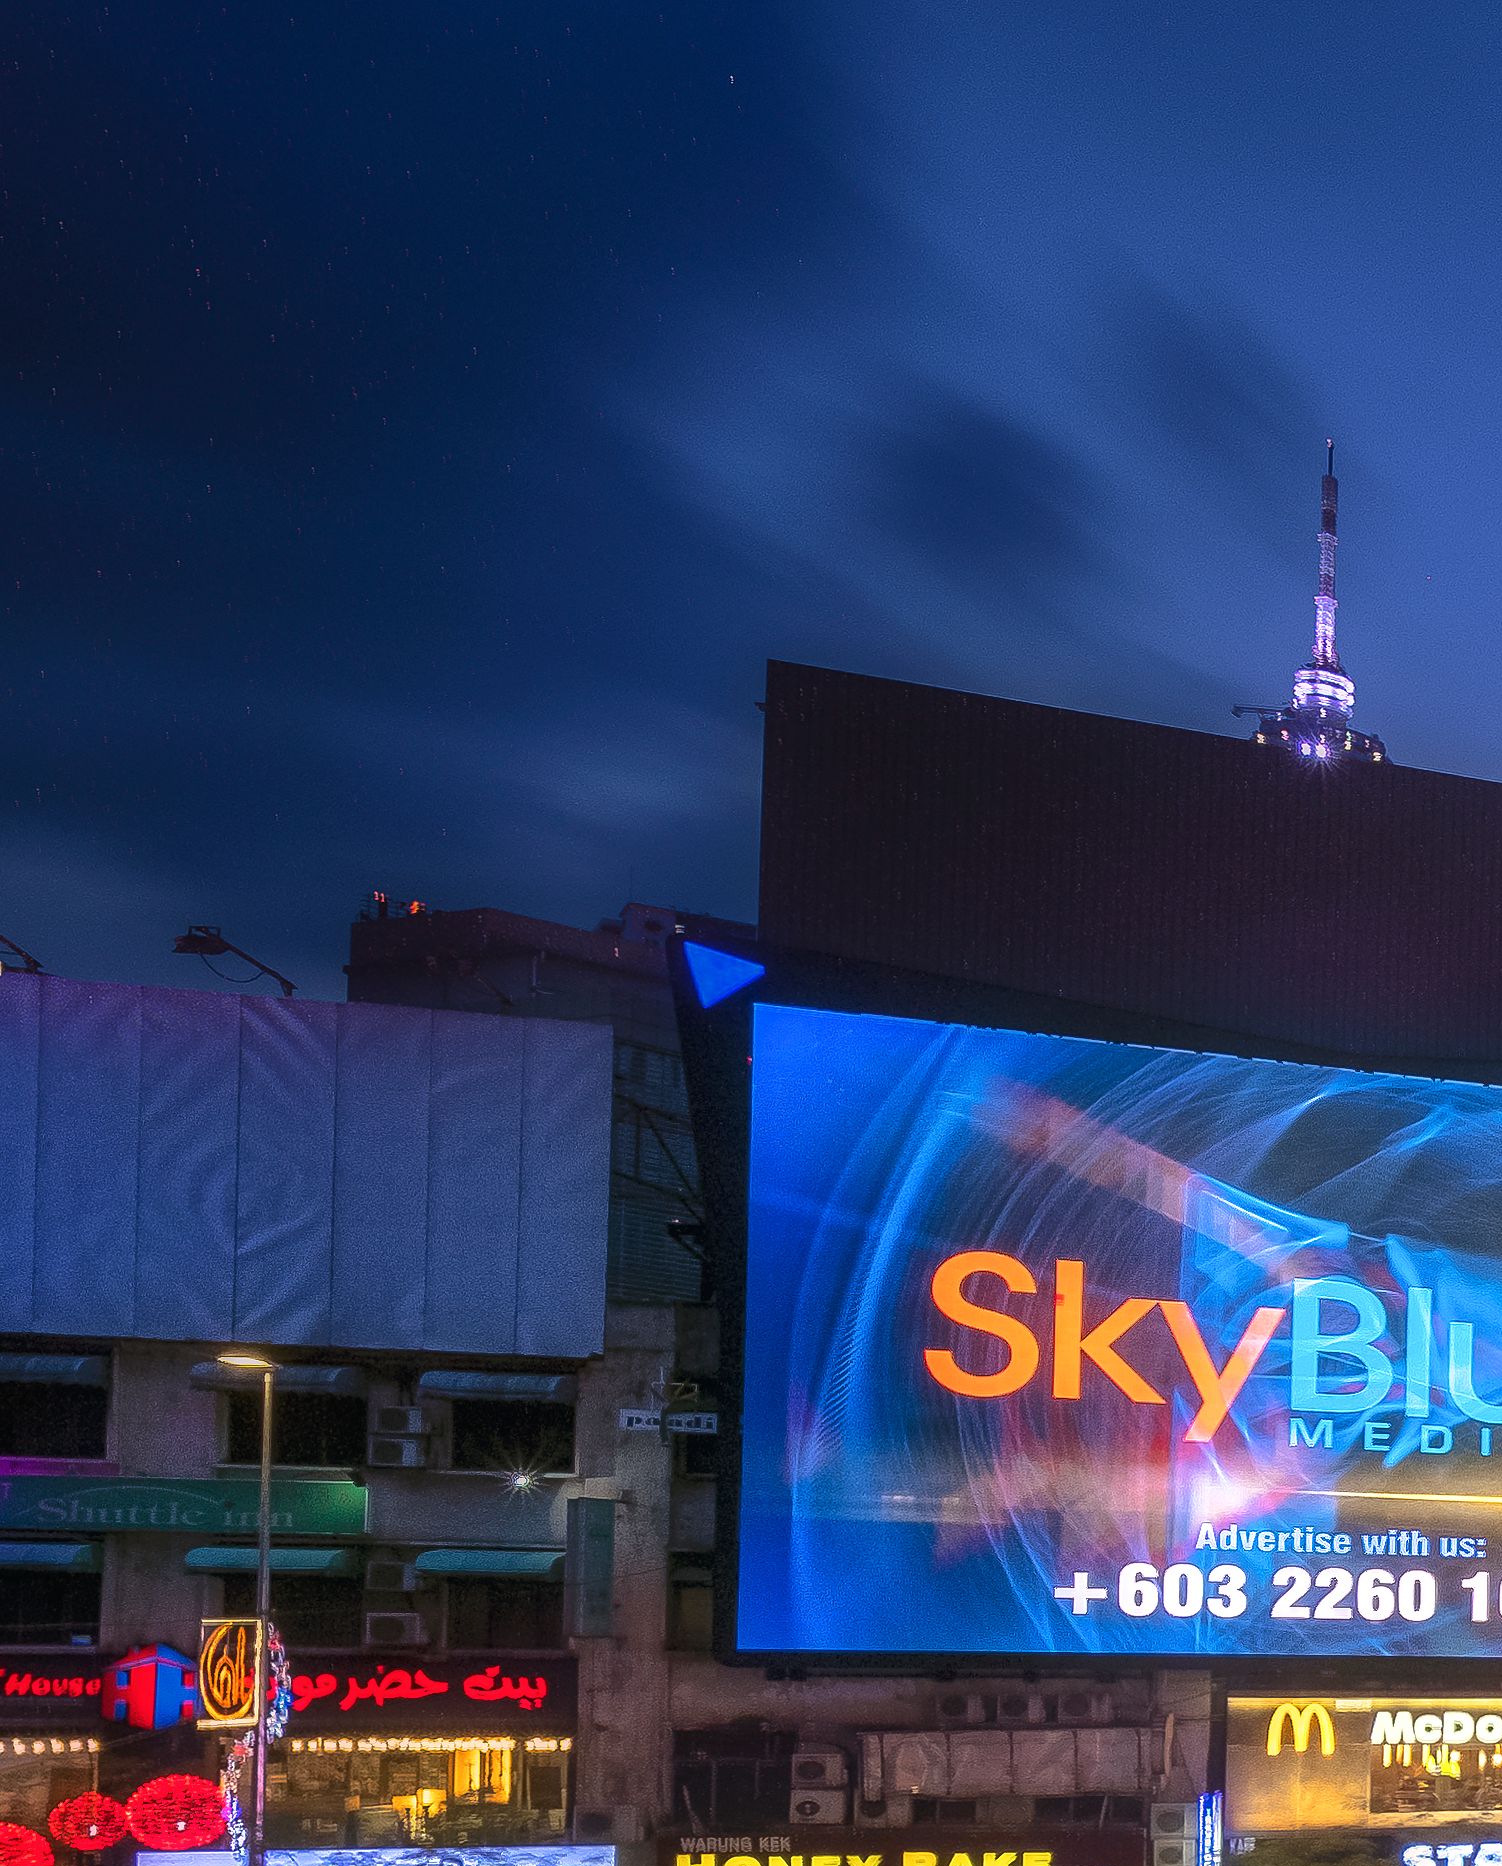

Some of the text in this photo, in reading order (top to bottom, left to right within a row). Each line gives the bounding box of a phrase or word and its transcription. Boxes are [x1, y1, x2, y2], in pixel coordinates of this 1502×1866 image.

[37, 1500, 204, 1528] Shuttle
[1195, 1522, 1488, 1560] Advertise with us:
[1053, 1563, 1247, 1621] +603
[1270, 1569, 1438, 1622] 2260
[680, 1837, 791, 1853] WARUNG KEK
